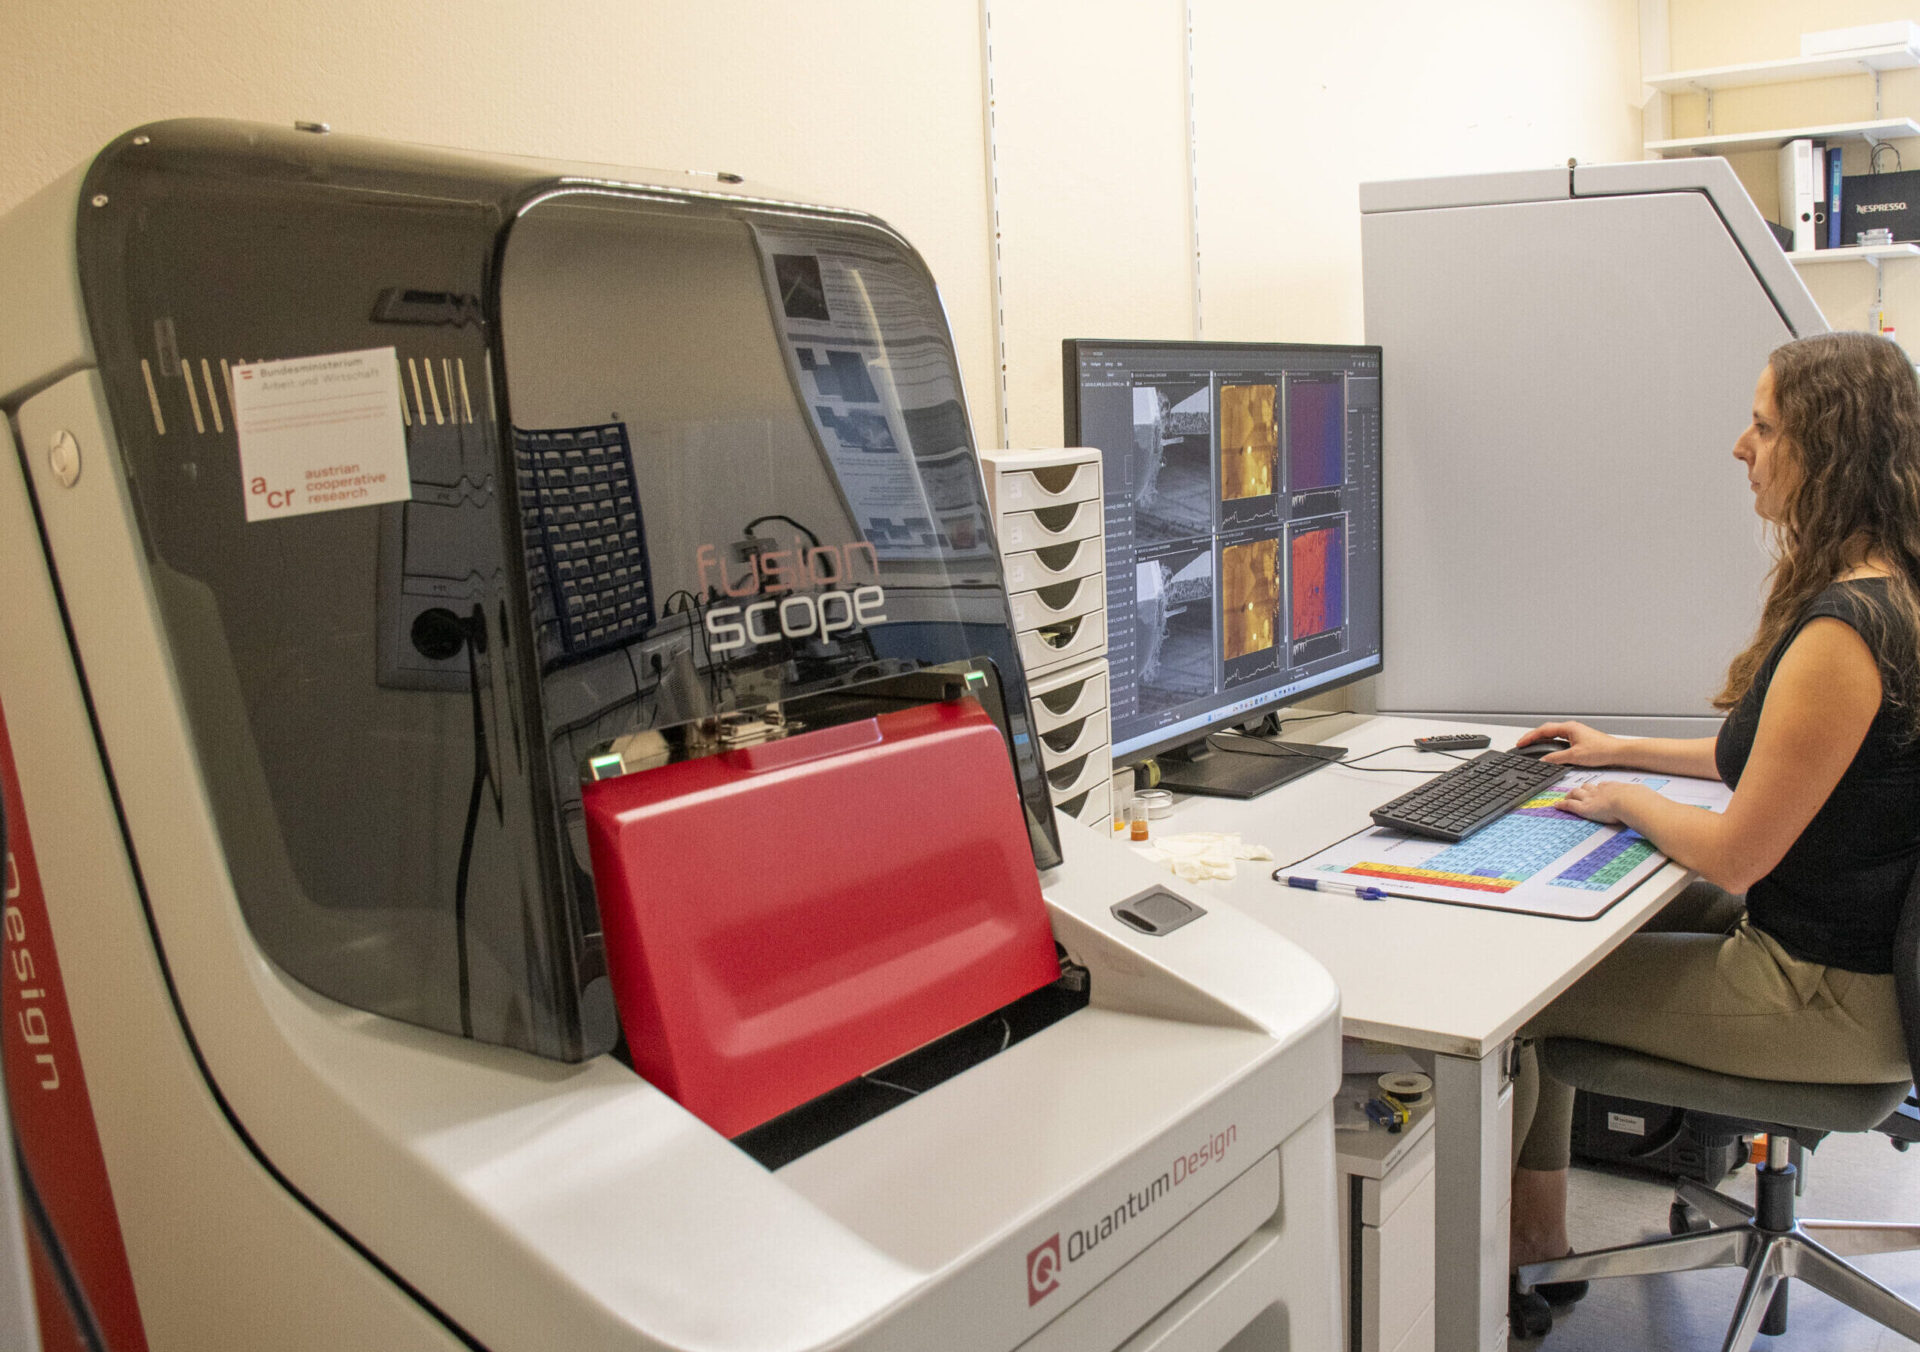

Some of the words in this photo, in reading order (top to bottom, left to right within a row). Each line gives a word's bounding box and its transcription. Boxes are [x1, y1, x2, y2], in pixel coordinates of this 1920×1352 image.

[1855, 202, 1907, 215] NESPRESSO
[260, 357, 363, 378] Bundesministerium
[262, 378, 295, 391] Arbeit
[298, 375, 319, 386] und
[323, 368, 380, 384] Wirtschaft
[305, 463, 360, 480] austrian
[305, 473, 387, 492] cooperative
[308, 487, 368, 505] research
[696, 535, 880, 605] fusion
[705, 585, 888, 653] scope
